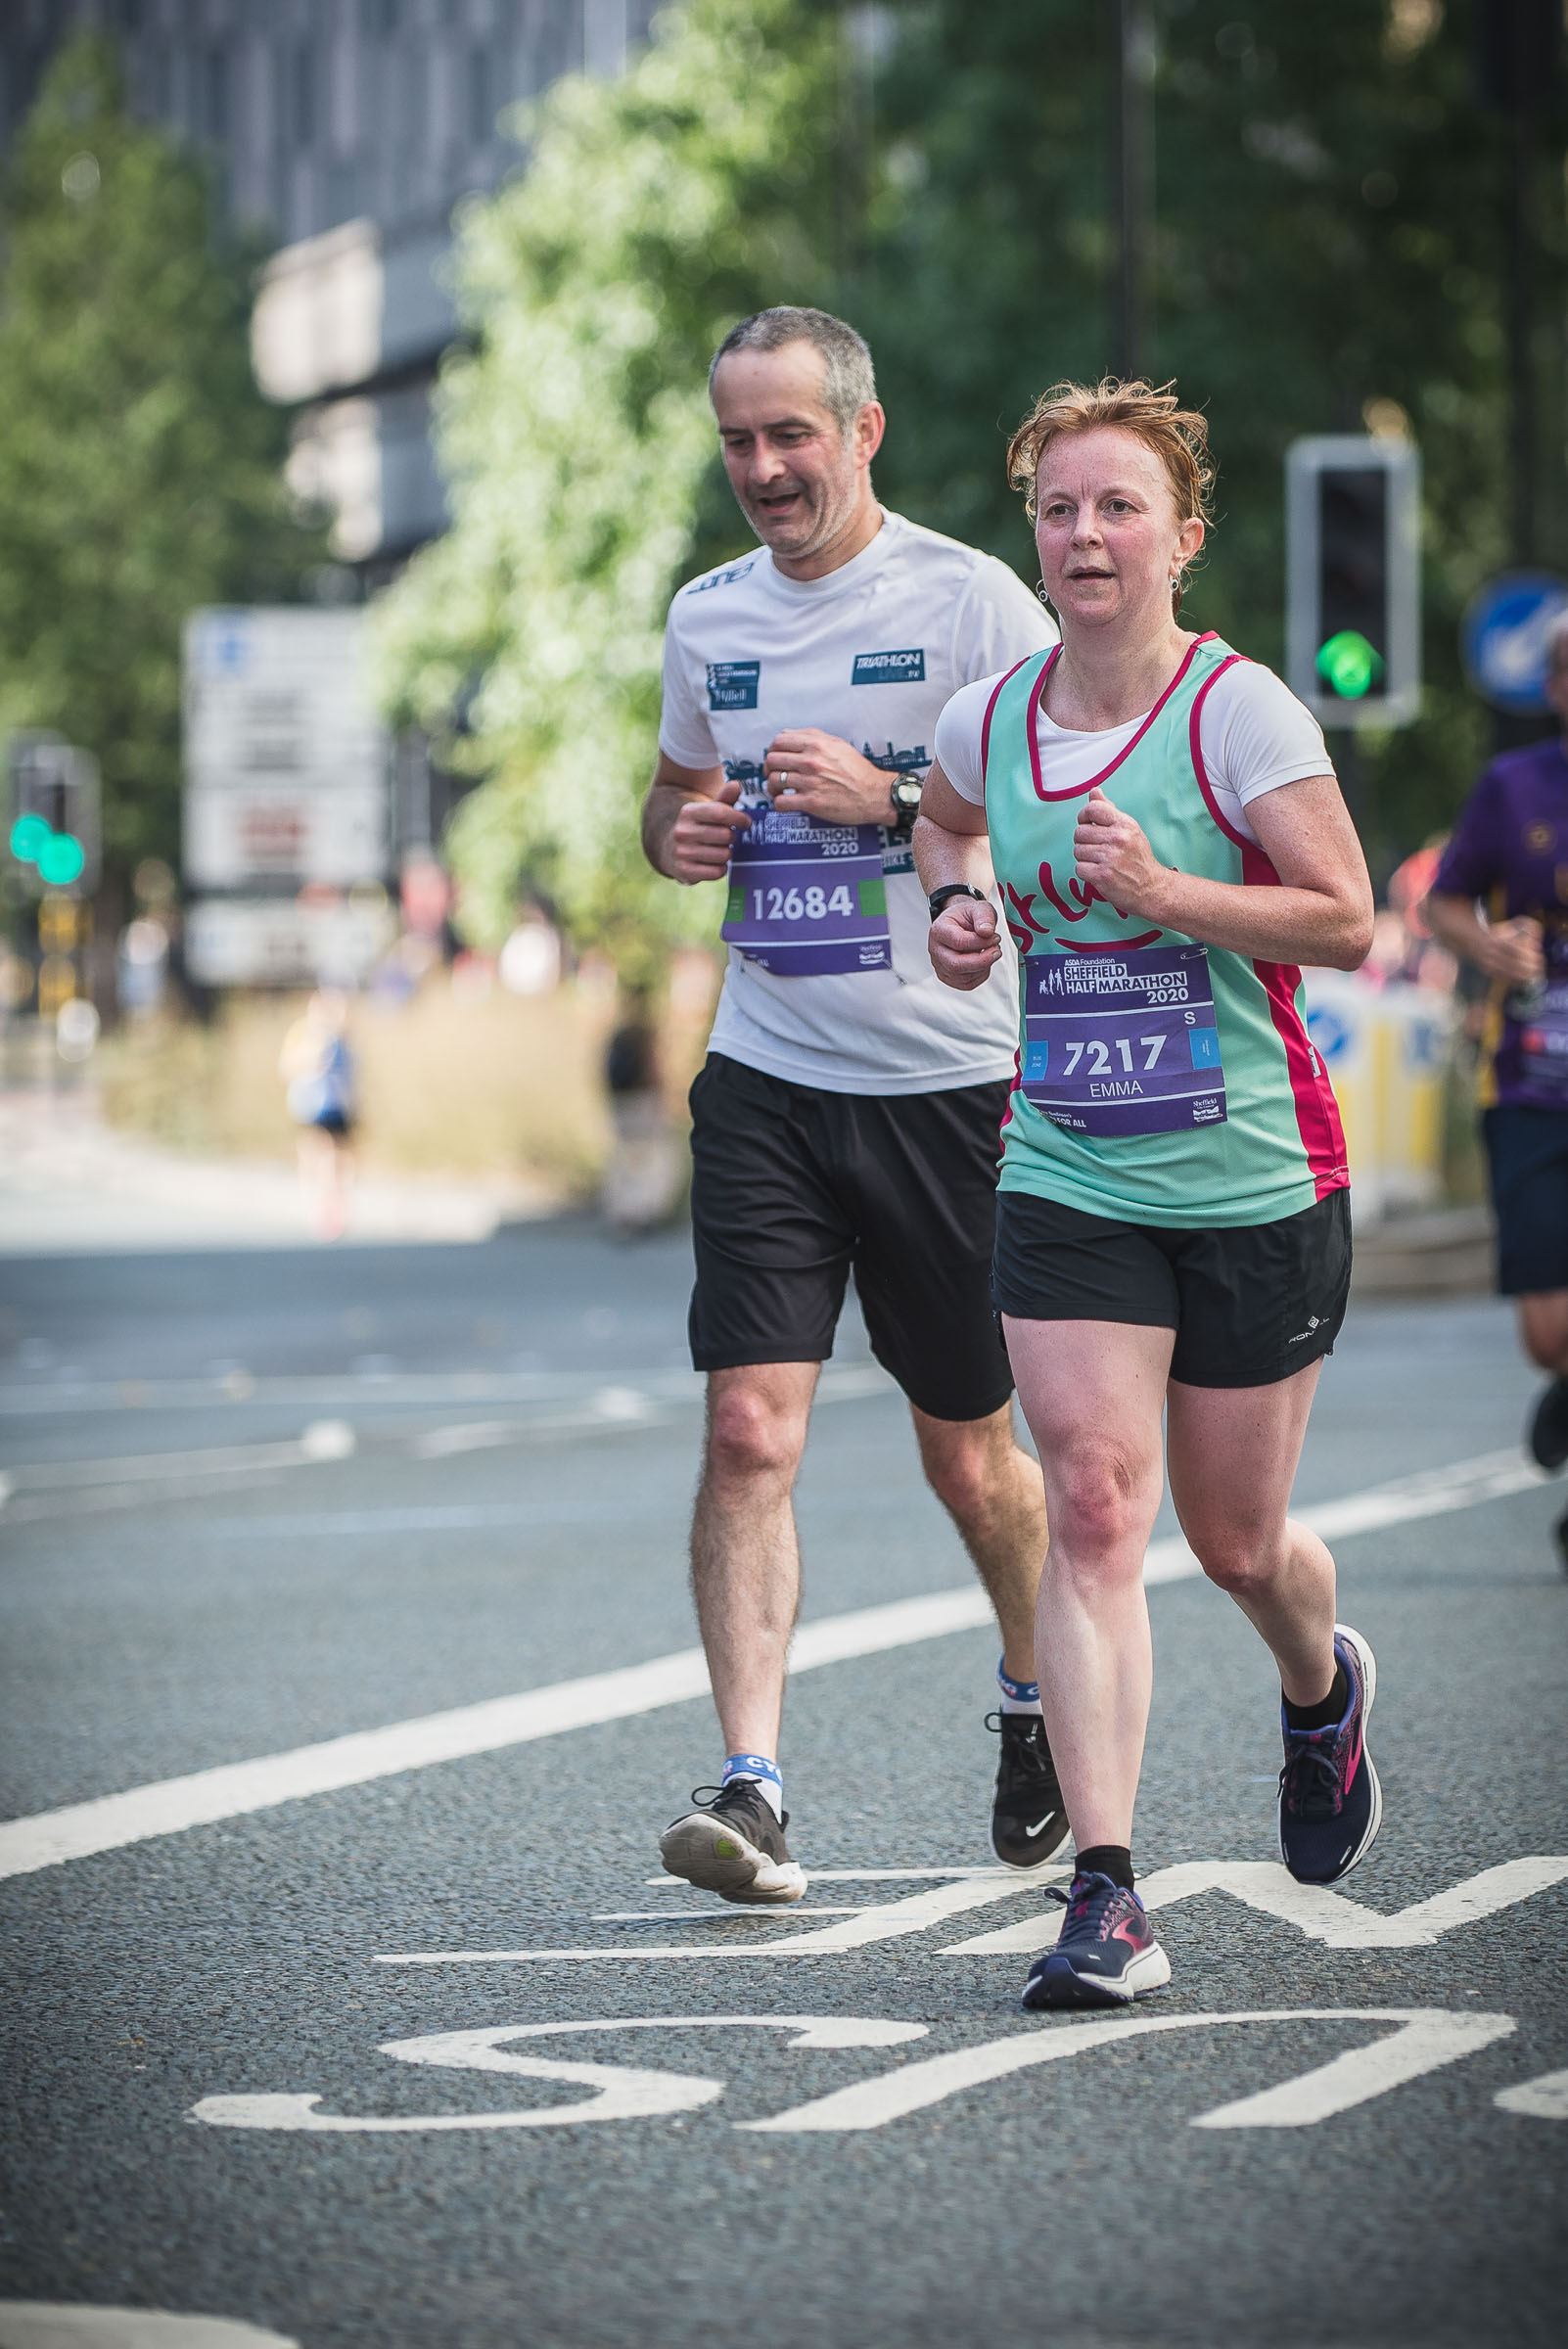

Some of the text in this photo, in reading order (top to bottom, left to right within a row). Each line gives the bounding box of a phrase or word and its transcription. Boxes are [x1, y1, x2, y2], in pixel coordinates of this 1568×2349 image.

[856, 653, 921, 668] TRIATHLON
[787, 827, 857, 844] MARATHON
[821, 843, 858, 855] 2020
[753, 885, 854, 920] 12684
[1065, 965, 1126, 980] SHEFFIELD
[1067, 972, 1186, 994] HALF MARATHON
[1147, 988, 1189, 1004] 2020
[1183, 1011, 1197, 1026] S
[1062, 1035, 1168, 1077] 7217
[1089, 1080, 1144, 1098] EMMA
